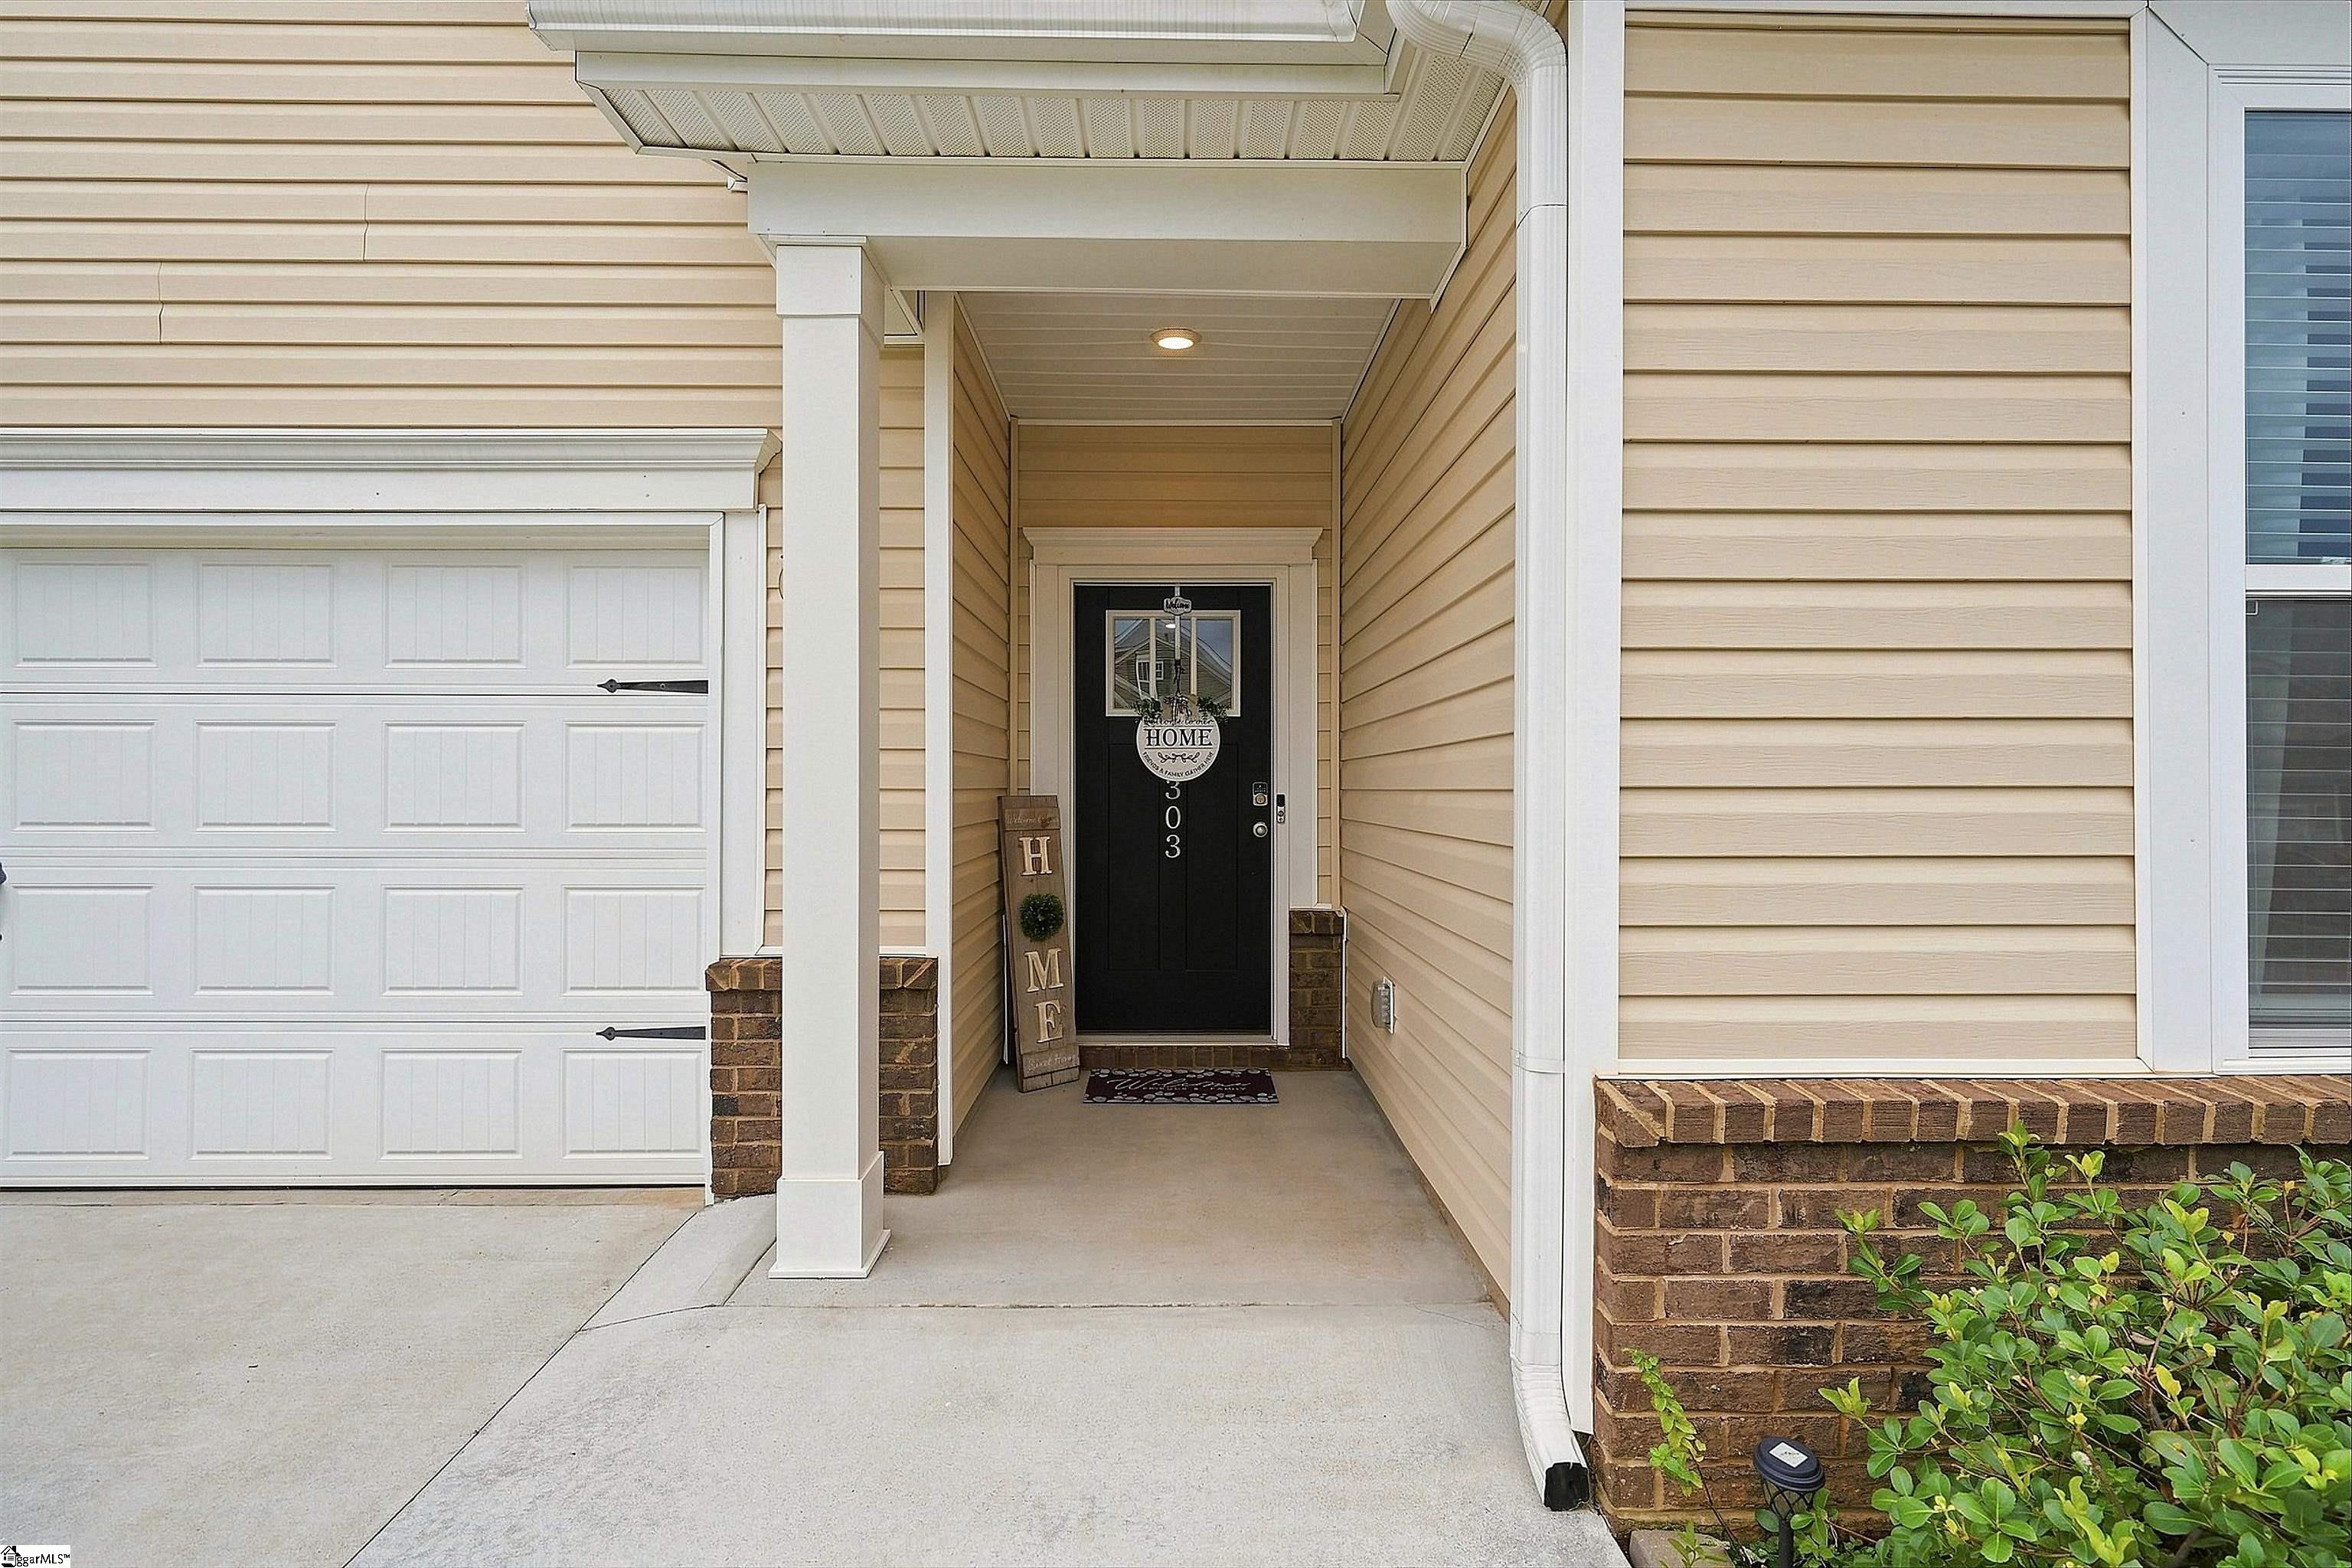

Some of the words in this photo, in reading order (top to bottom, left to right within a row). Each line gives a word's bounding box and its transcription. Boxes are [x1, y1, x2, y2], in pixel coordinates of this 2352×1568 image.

[1143, 727, 1214, 747] HOME
[1142, 751, 1160, 771] FRIENDS
[1164, 769, 1184, 778] FAMILY
[1184, 762, 1206, 776] GATHER
[1204, 751, 1215, 765] HERE
[1165, 780, 1181, 858] 303
